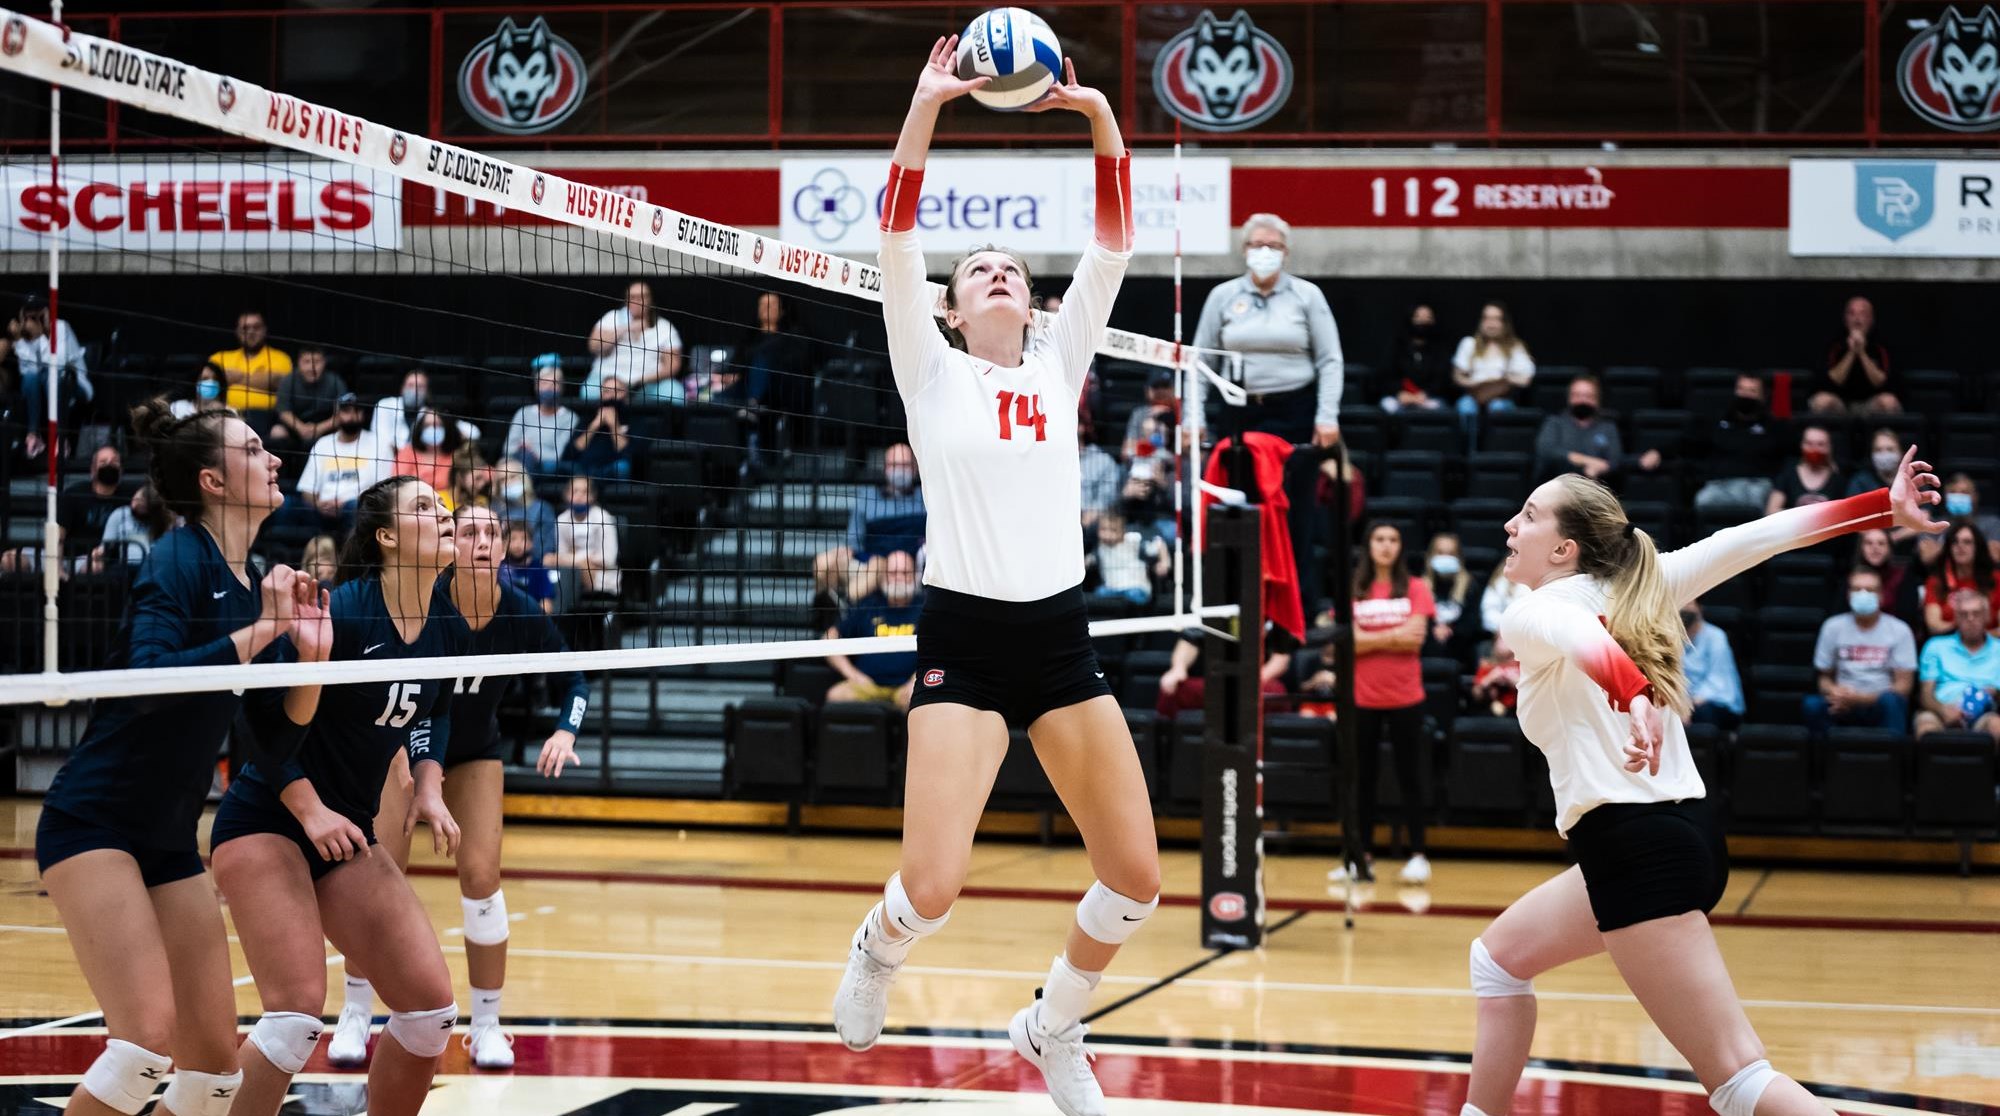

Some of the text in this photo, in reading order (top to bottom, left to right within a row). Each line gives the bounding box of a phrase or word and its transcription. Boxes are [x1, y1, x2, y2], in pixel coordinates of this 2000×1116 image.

[143, 58, 187, 100] STATE
[267, 92, 363, 155] HUSKIES
[19, 180, 374, 233] SCHEELS
[565, 183, 636, 229] HUSKIES
[1371, 176, 1612, 218] 112 RESERVED
[996, 389, 1047, 442] 14
[374, 682, 422, 728] 15
